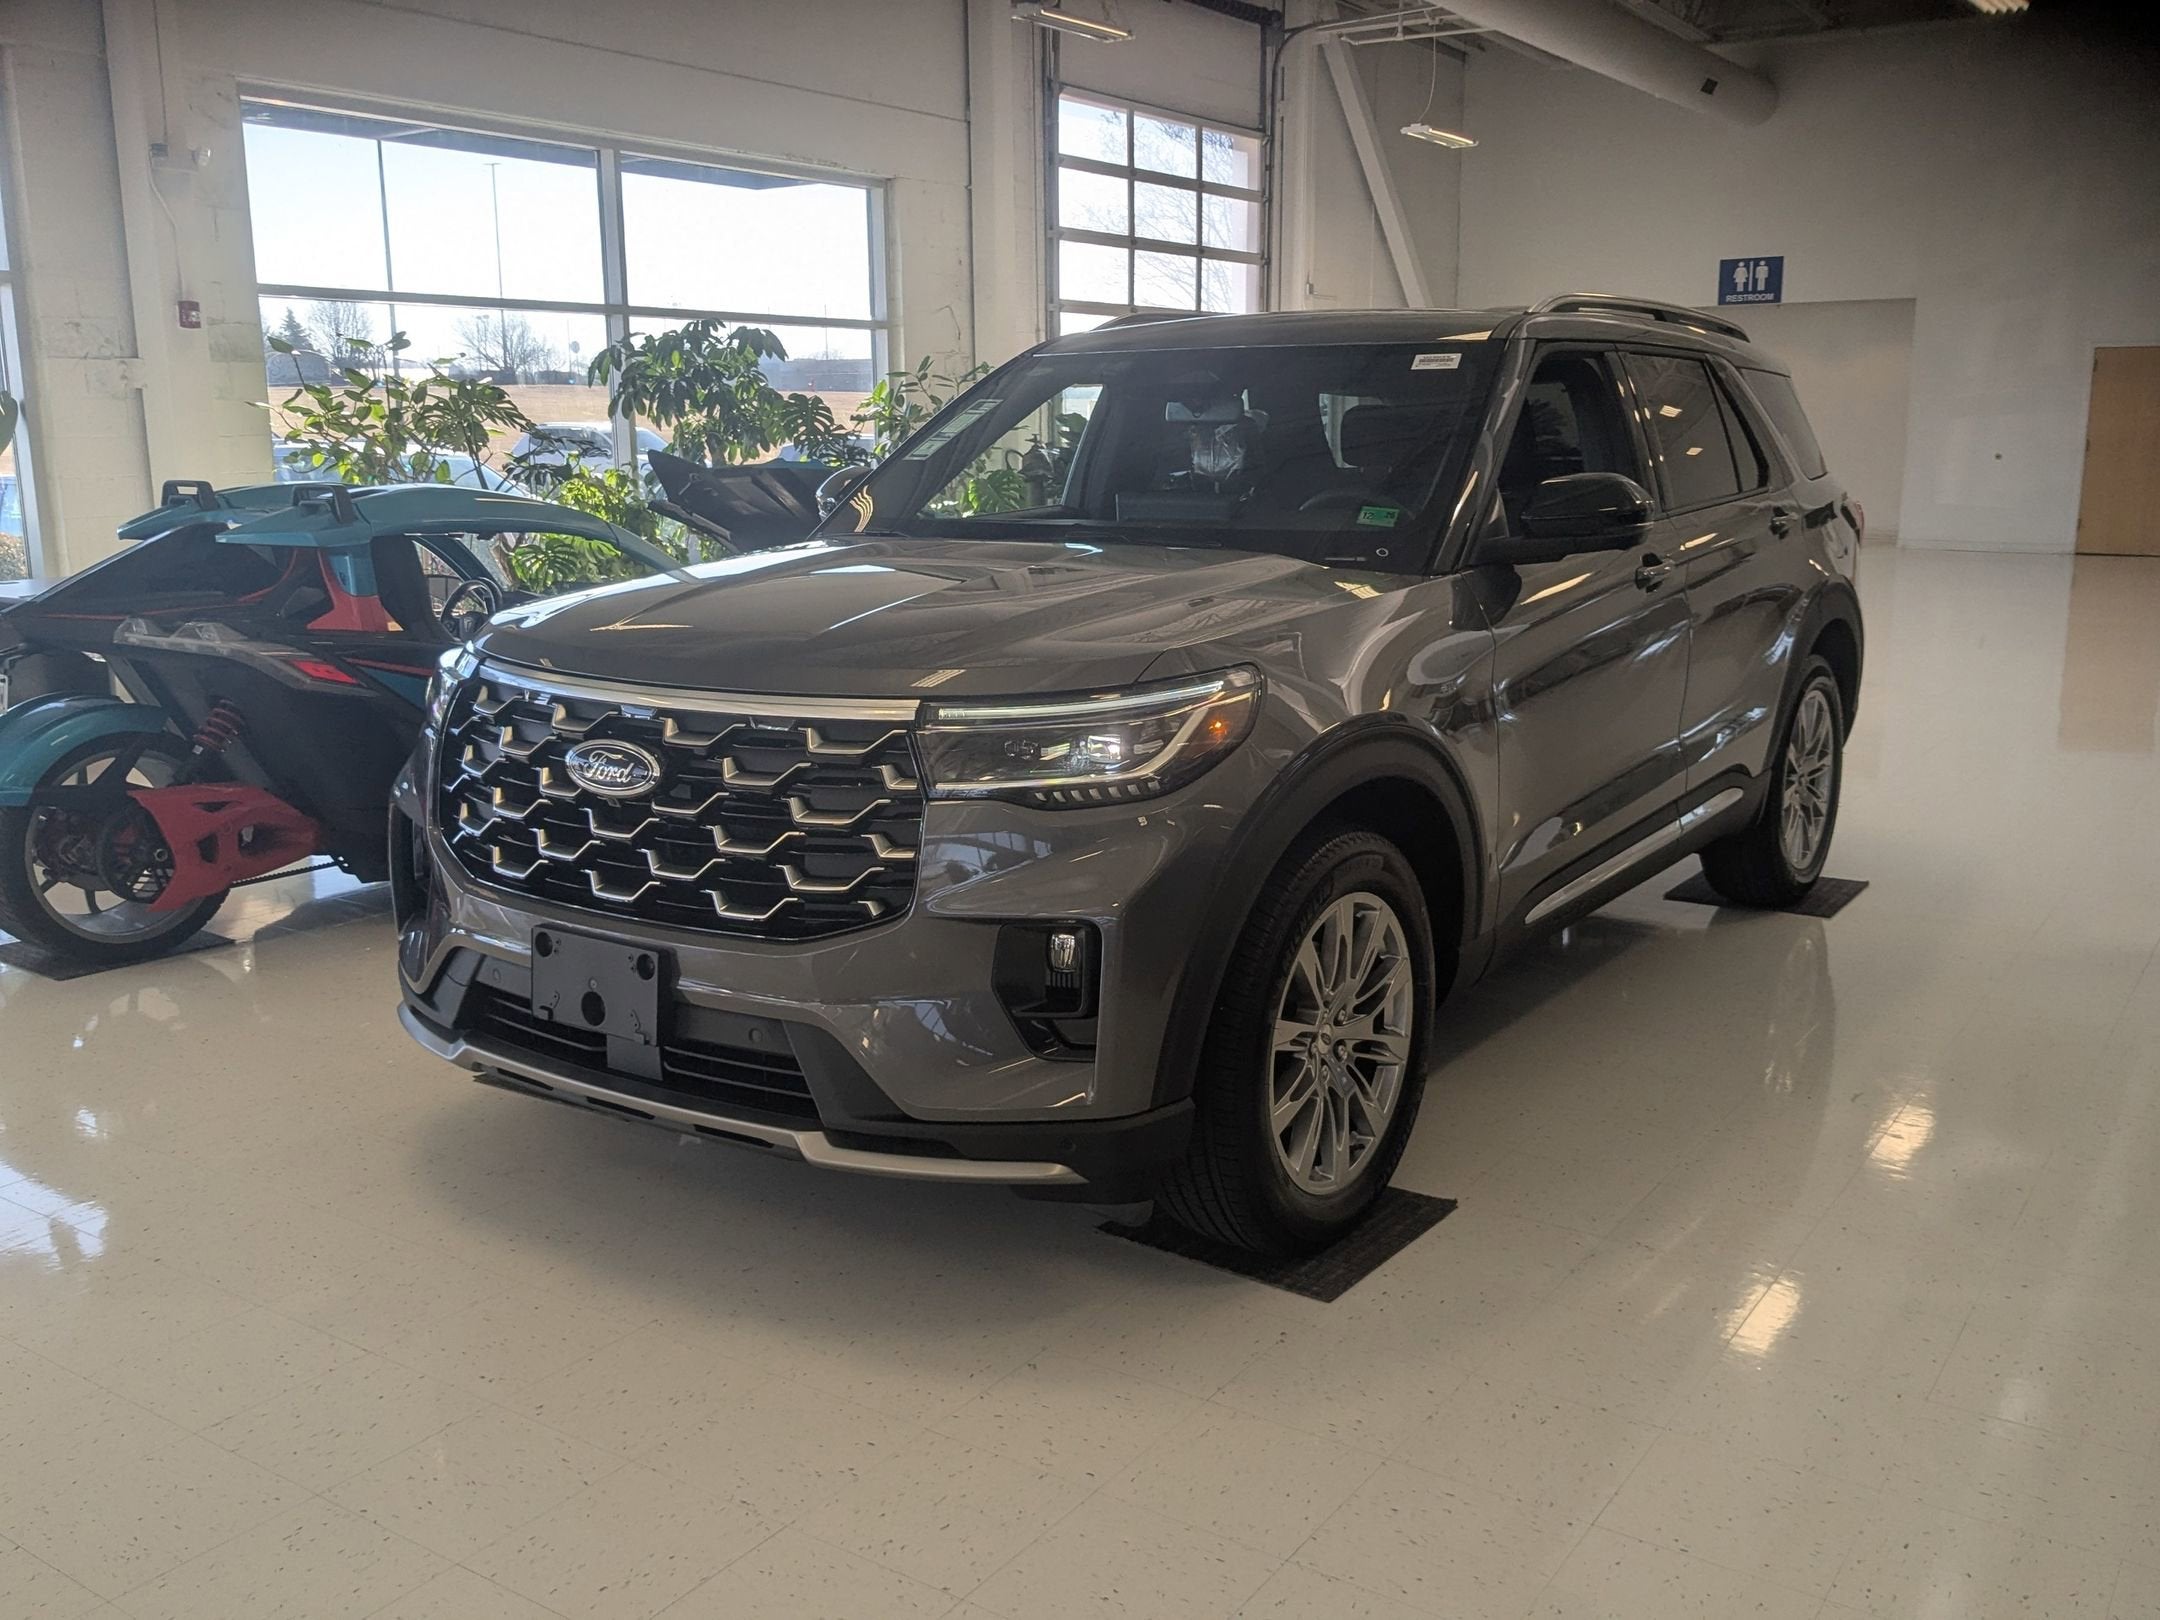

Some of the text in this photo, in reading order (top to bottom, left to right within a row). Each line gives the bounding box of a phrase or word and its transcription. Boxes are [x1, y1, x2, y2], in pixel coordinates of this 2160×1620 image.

[1726, 293, 1775, 303] RESTROOM
[1362, 511, 1376, 520] 12
[582, 750, 635, 783] Ford
